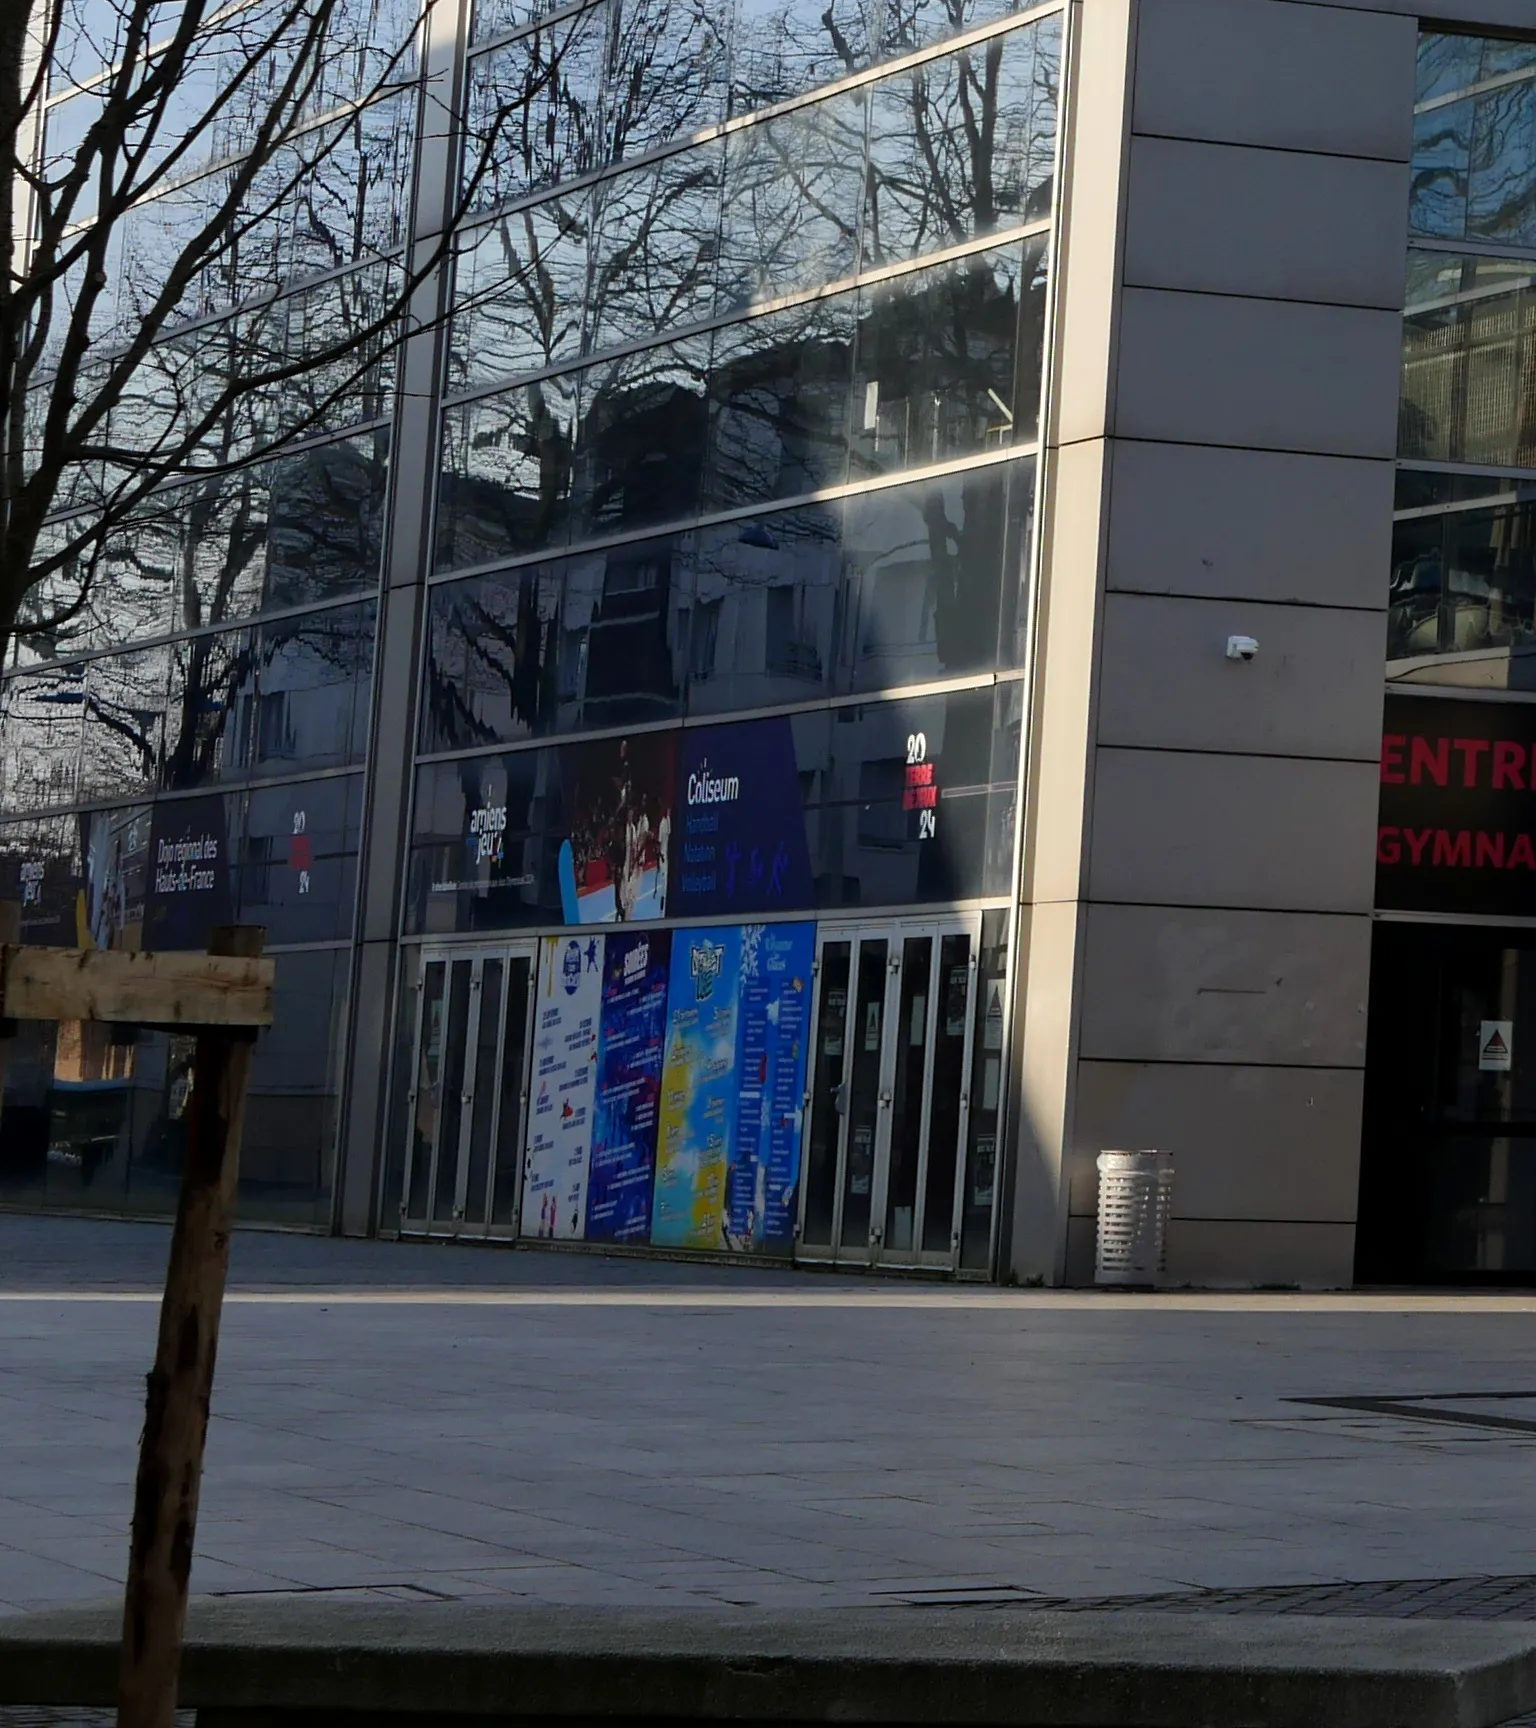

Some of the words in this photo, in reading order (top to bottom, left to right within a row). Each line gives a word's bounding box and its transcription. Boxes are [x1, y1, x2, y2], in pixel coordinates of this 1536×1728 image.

[906, 732, 926, 764] 20
[687, 771, 739, 806] Coliseum
[470, 802, 507, 834] amiens
[919, 809, 936, 839] 24
[158, 839, 173, 864] Dojo
[175, 833, 205, 862] régional
[205, 834, 218, 860] des
[155, 864, 215, 894] Hauts-de-France
